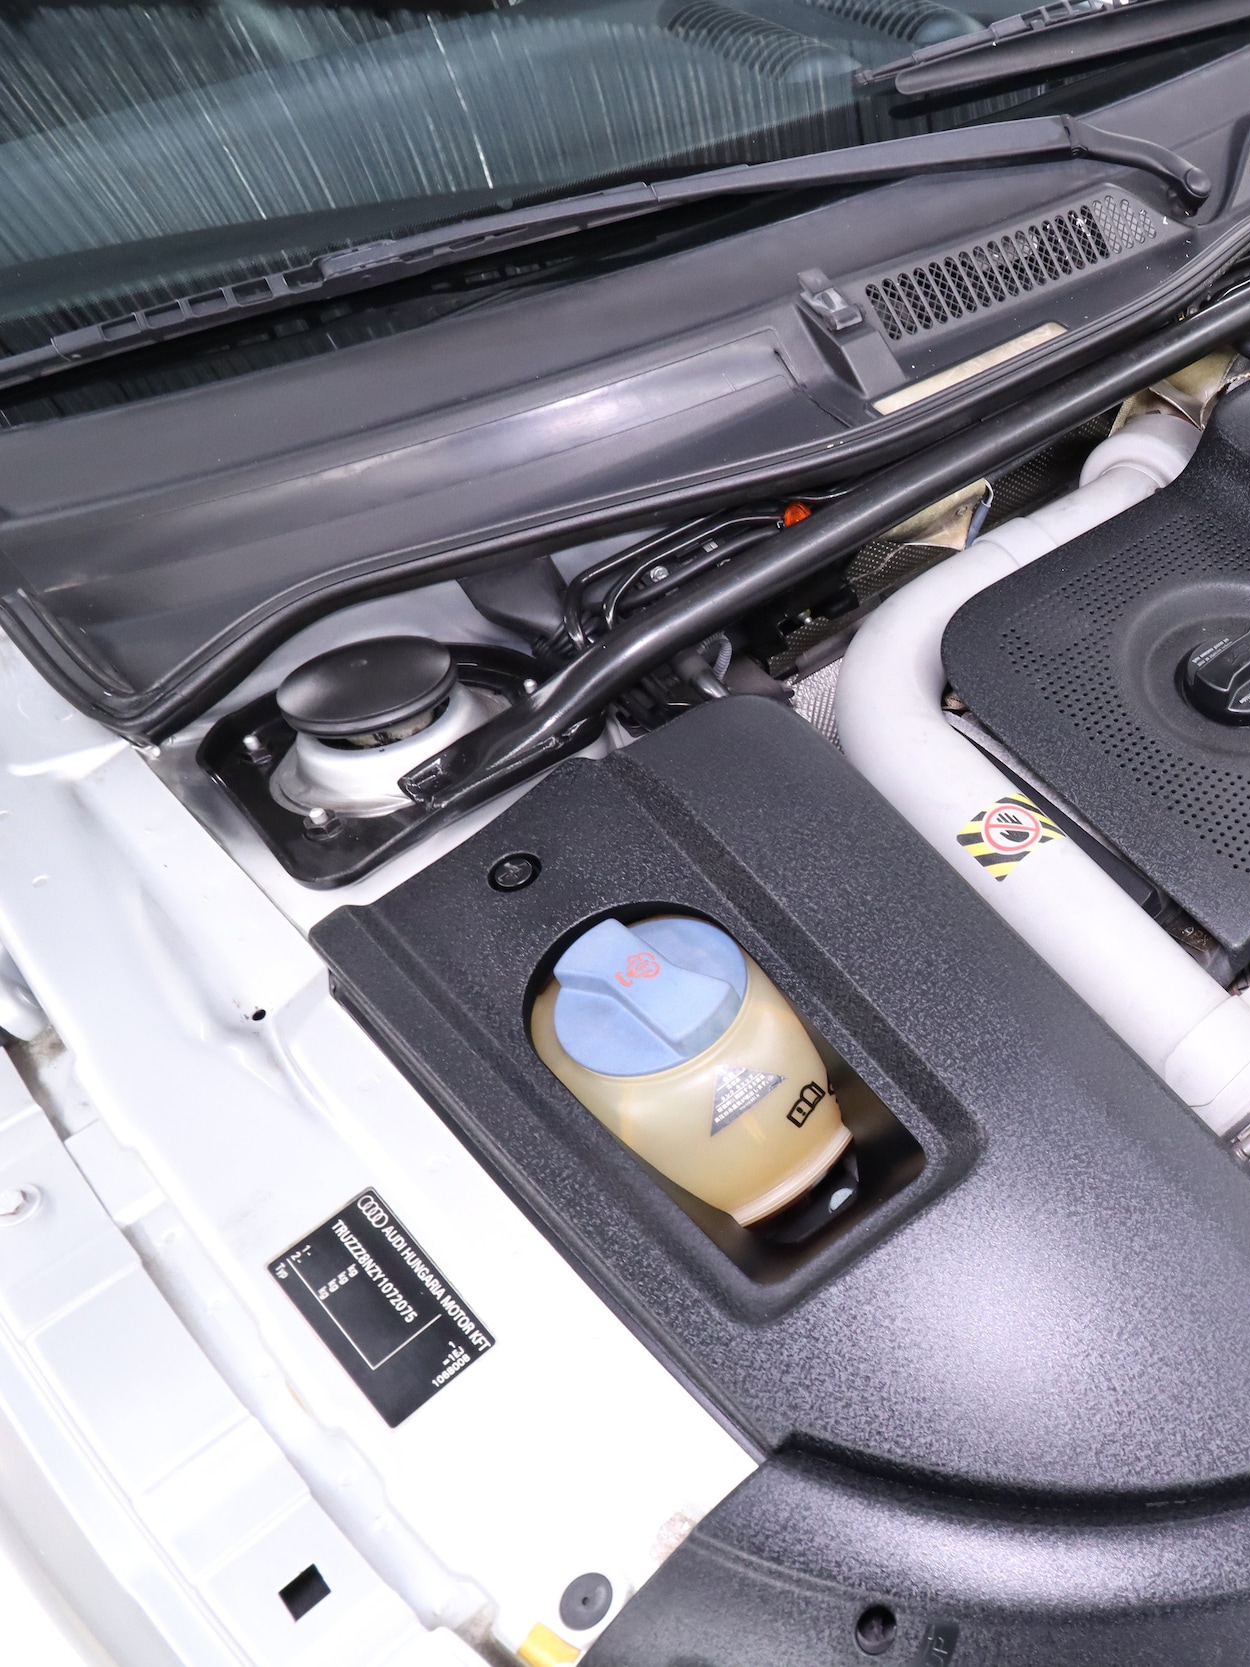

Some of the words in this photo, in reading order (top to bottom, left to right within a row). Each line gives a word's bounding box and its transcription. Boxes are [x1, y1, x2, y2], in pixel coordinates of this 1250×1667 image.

[274, 1261, 289, 1280] Typ
[332, 1219, 419, 1323] TRUZZZ8NZY1072075
[336, 1271, 351, 1286] kg
[346, 1263, 359, 1279] kg
[317, 1285, 331, 1301] kg
[327, 1278, 341, 1294] kg
[381, 1225, 408, 1252] AUDI
[400, 1246, 446, 1300] HUNGARIA
[439, 1294, 475, 1335] MOTOR
[468, 1329, 492, 1351] KFT
